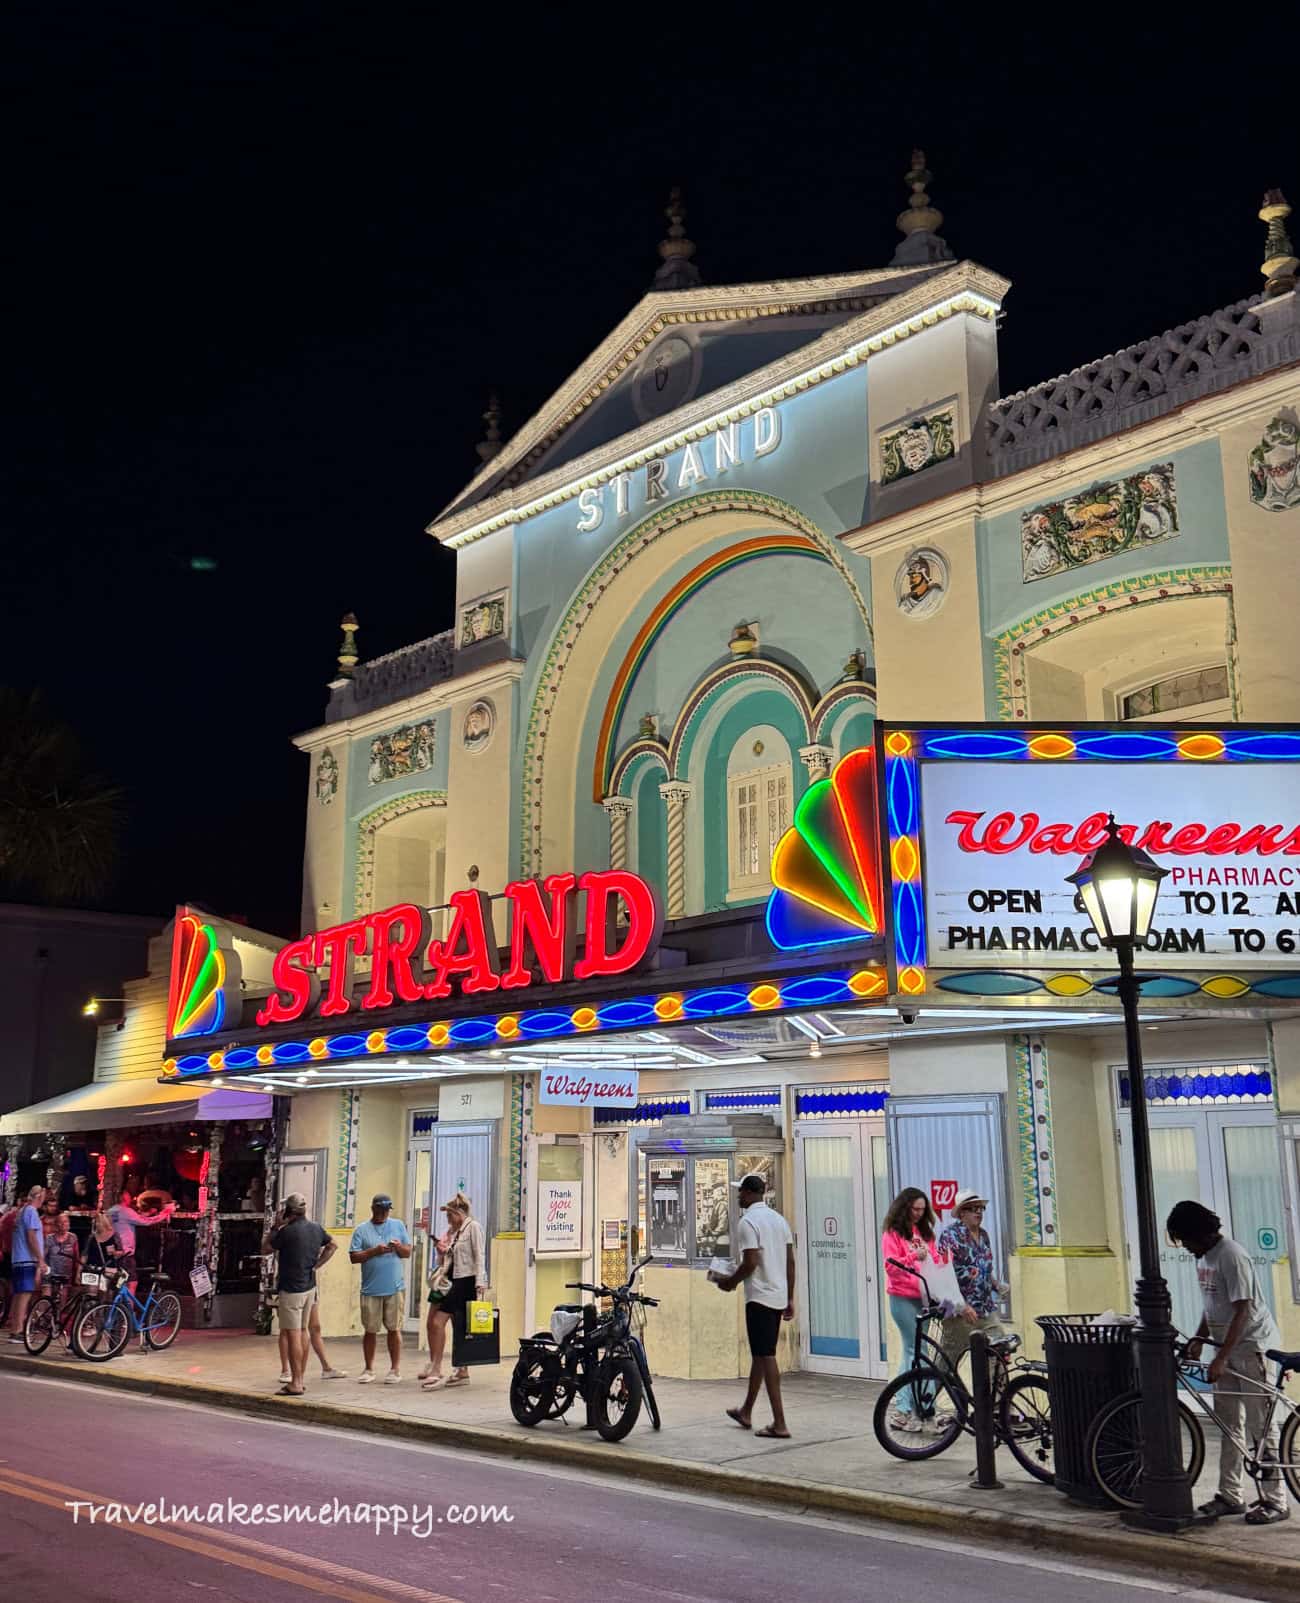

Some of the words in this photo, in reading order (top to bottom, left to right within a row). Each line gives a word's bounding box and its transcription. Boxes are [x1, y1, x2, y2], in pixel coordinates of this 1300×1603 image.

[576, 407, 782, 532] STRAND
[968, 889, 1042, 913] OPEN
[1275, 892, 1300, 915] A
[255, 869, 657, 1026] STRAND
[948, 925, 1112, 952] PHARMAC
[1229, 928, 1265, 953] TO
[545, 1076, 635, 1103] Walgreens
[549, 1189, 572, 1198] Thank
[547, 1200, 572, 1222] you
[556, 1210, 567, 1219] for
[545, 1222, 574, 1233] visiting
[811, 1239, 845, 1248] cosmetics
[816, 1250, 831, 1259] skin
[832, 1251, 848, 1260] care
